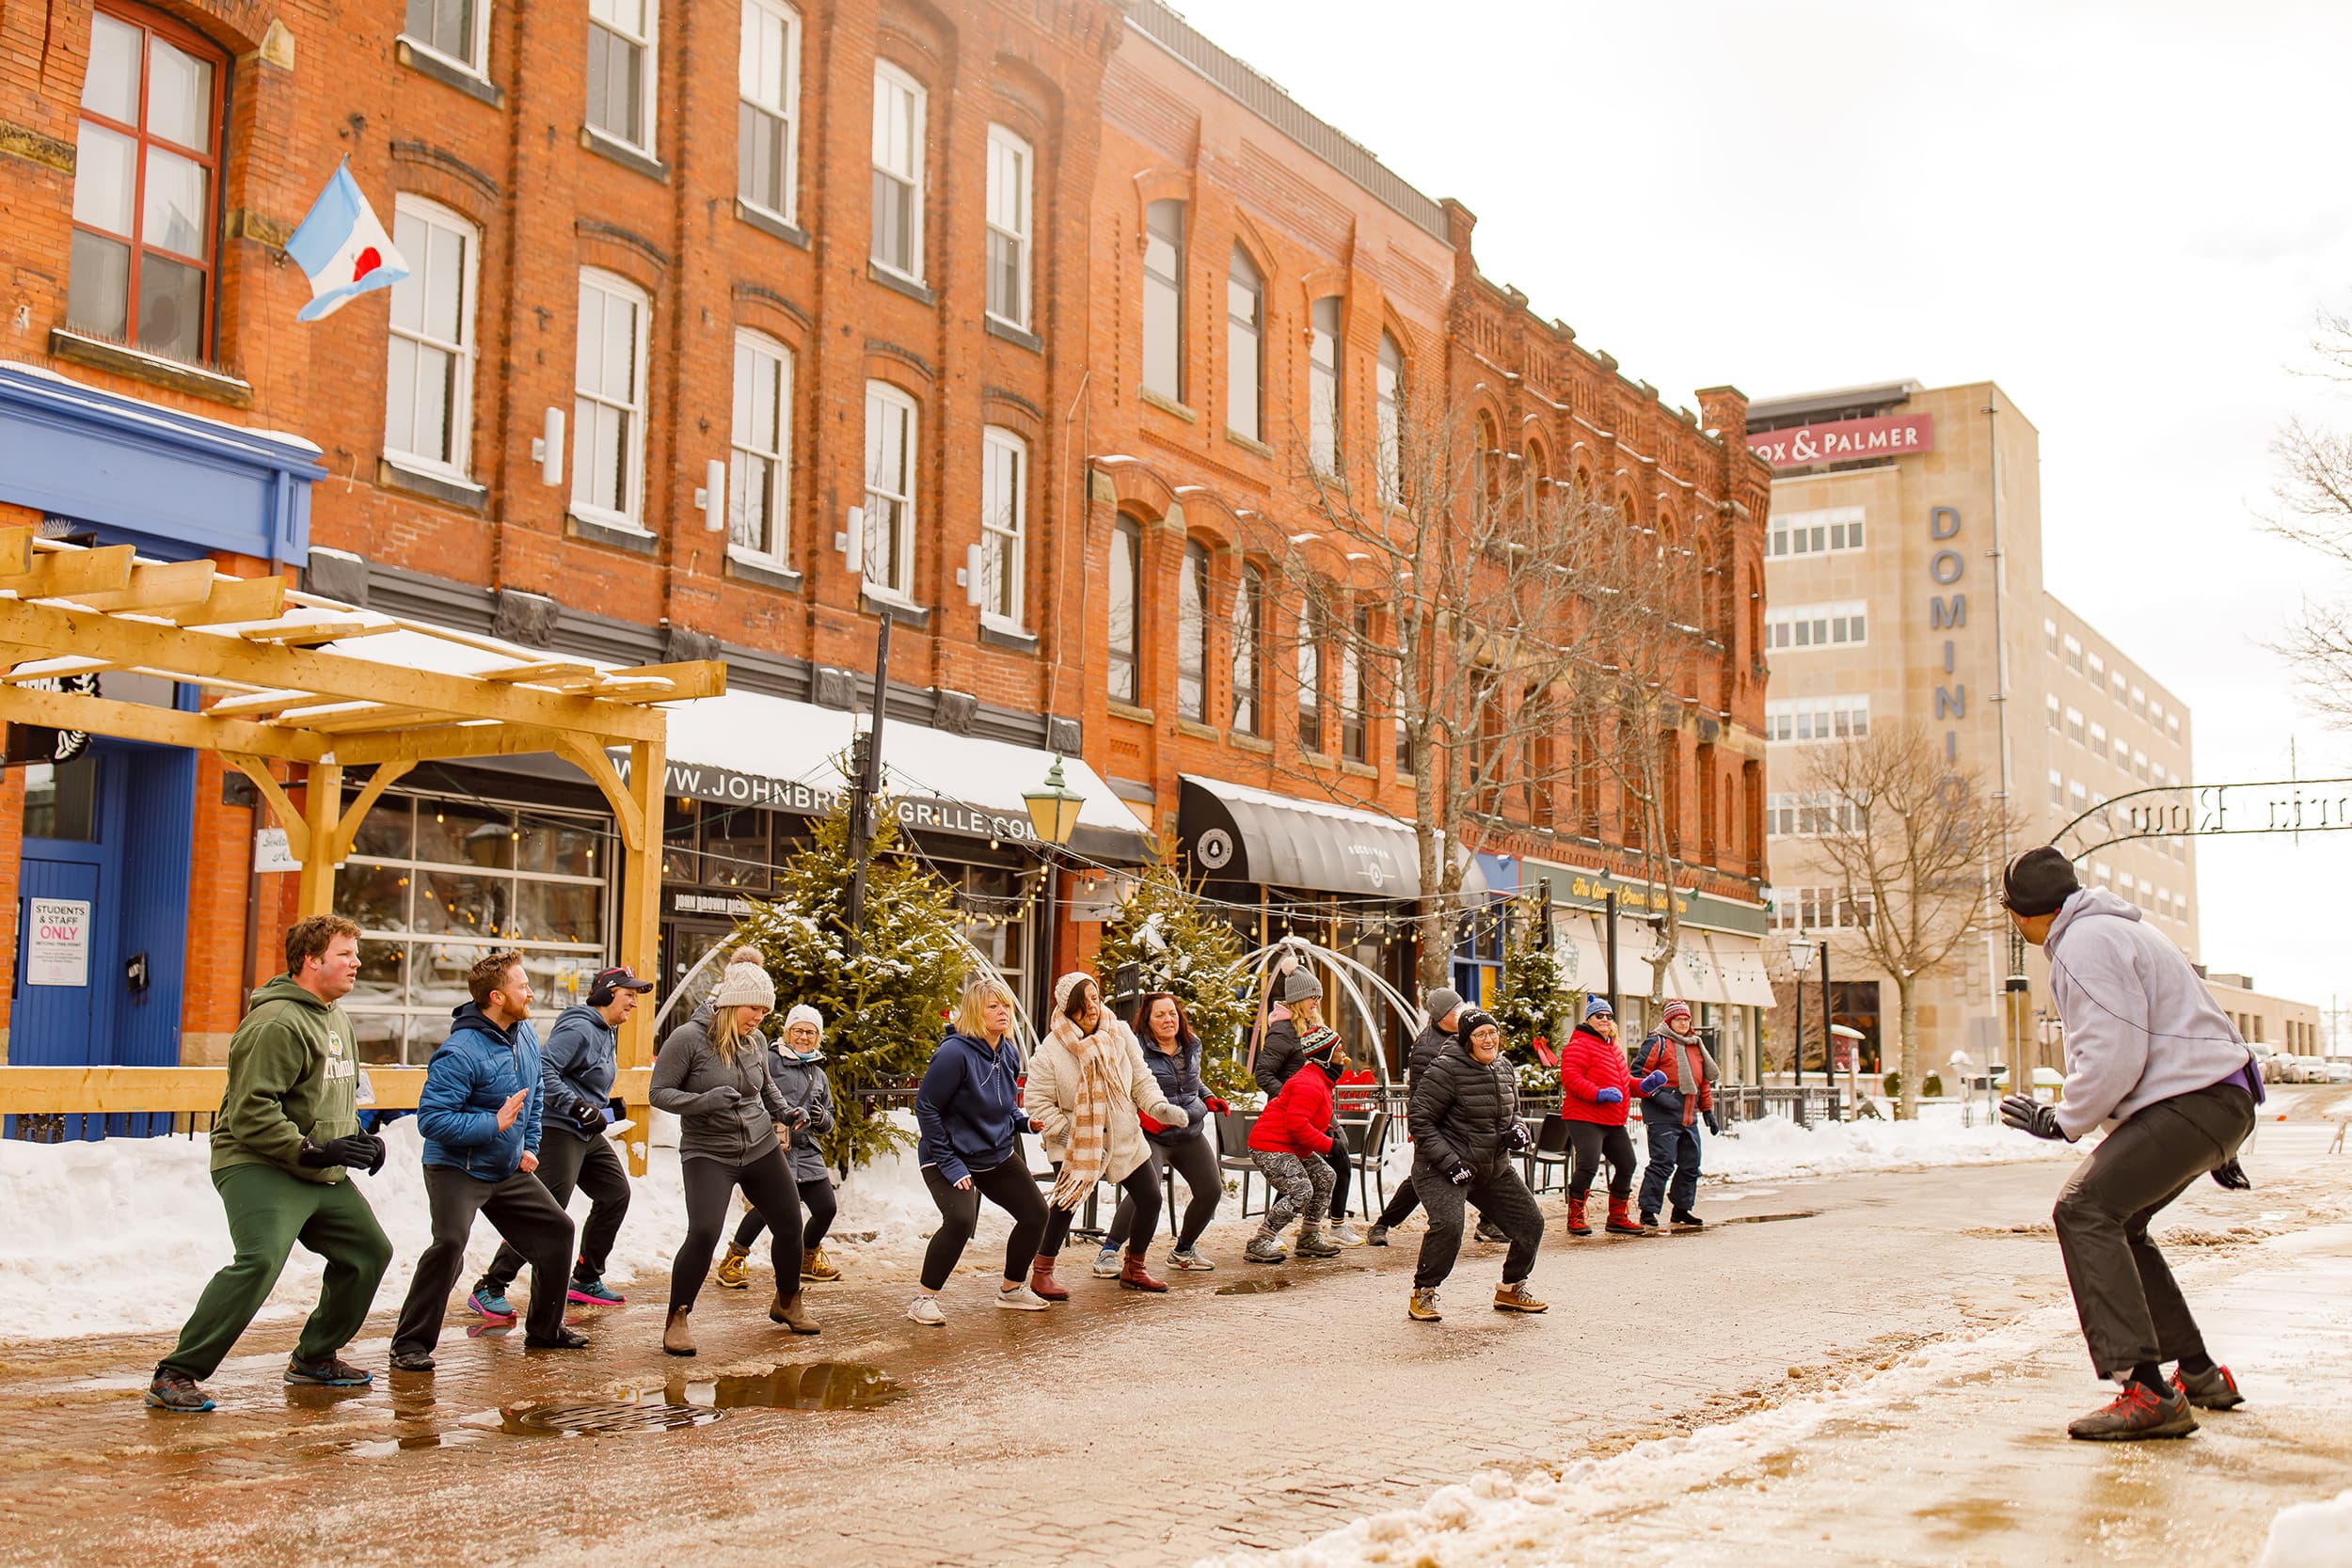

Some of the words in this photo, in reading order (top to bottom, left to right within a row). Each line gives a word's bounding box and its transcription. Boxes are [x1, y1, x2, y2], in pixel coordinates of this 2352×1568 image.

[1747, 442, 1786, 462] OX
[1791, 430, 1821, 461] &
[1823, 427, 1918, 453] PALMER
[36, 905, 86, 916] STUDENTS
[40, 915, 46, 924] &
[48, 916, 78, 925] STAFF
[40, 926, 78, 941] ONLY
